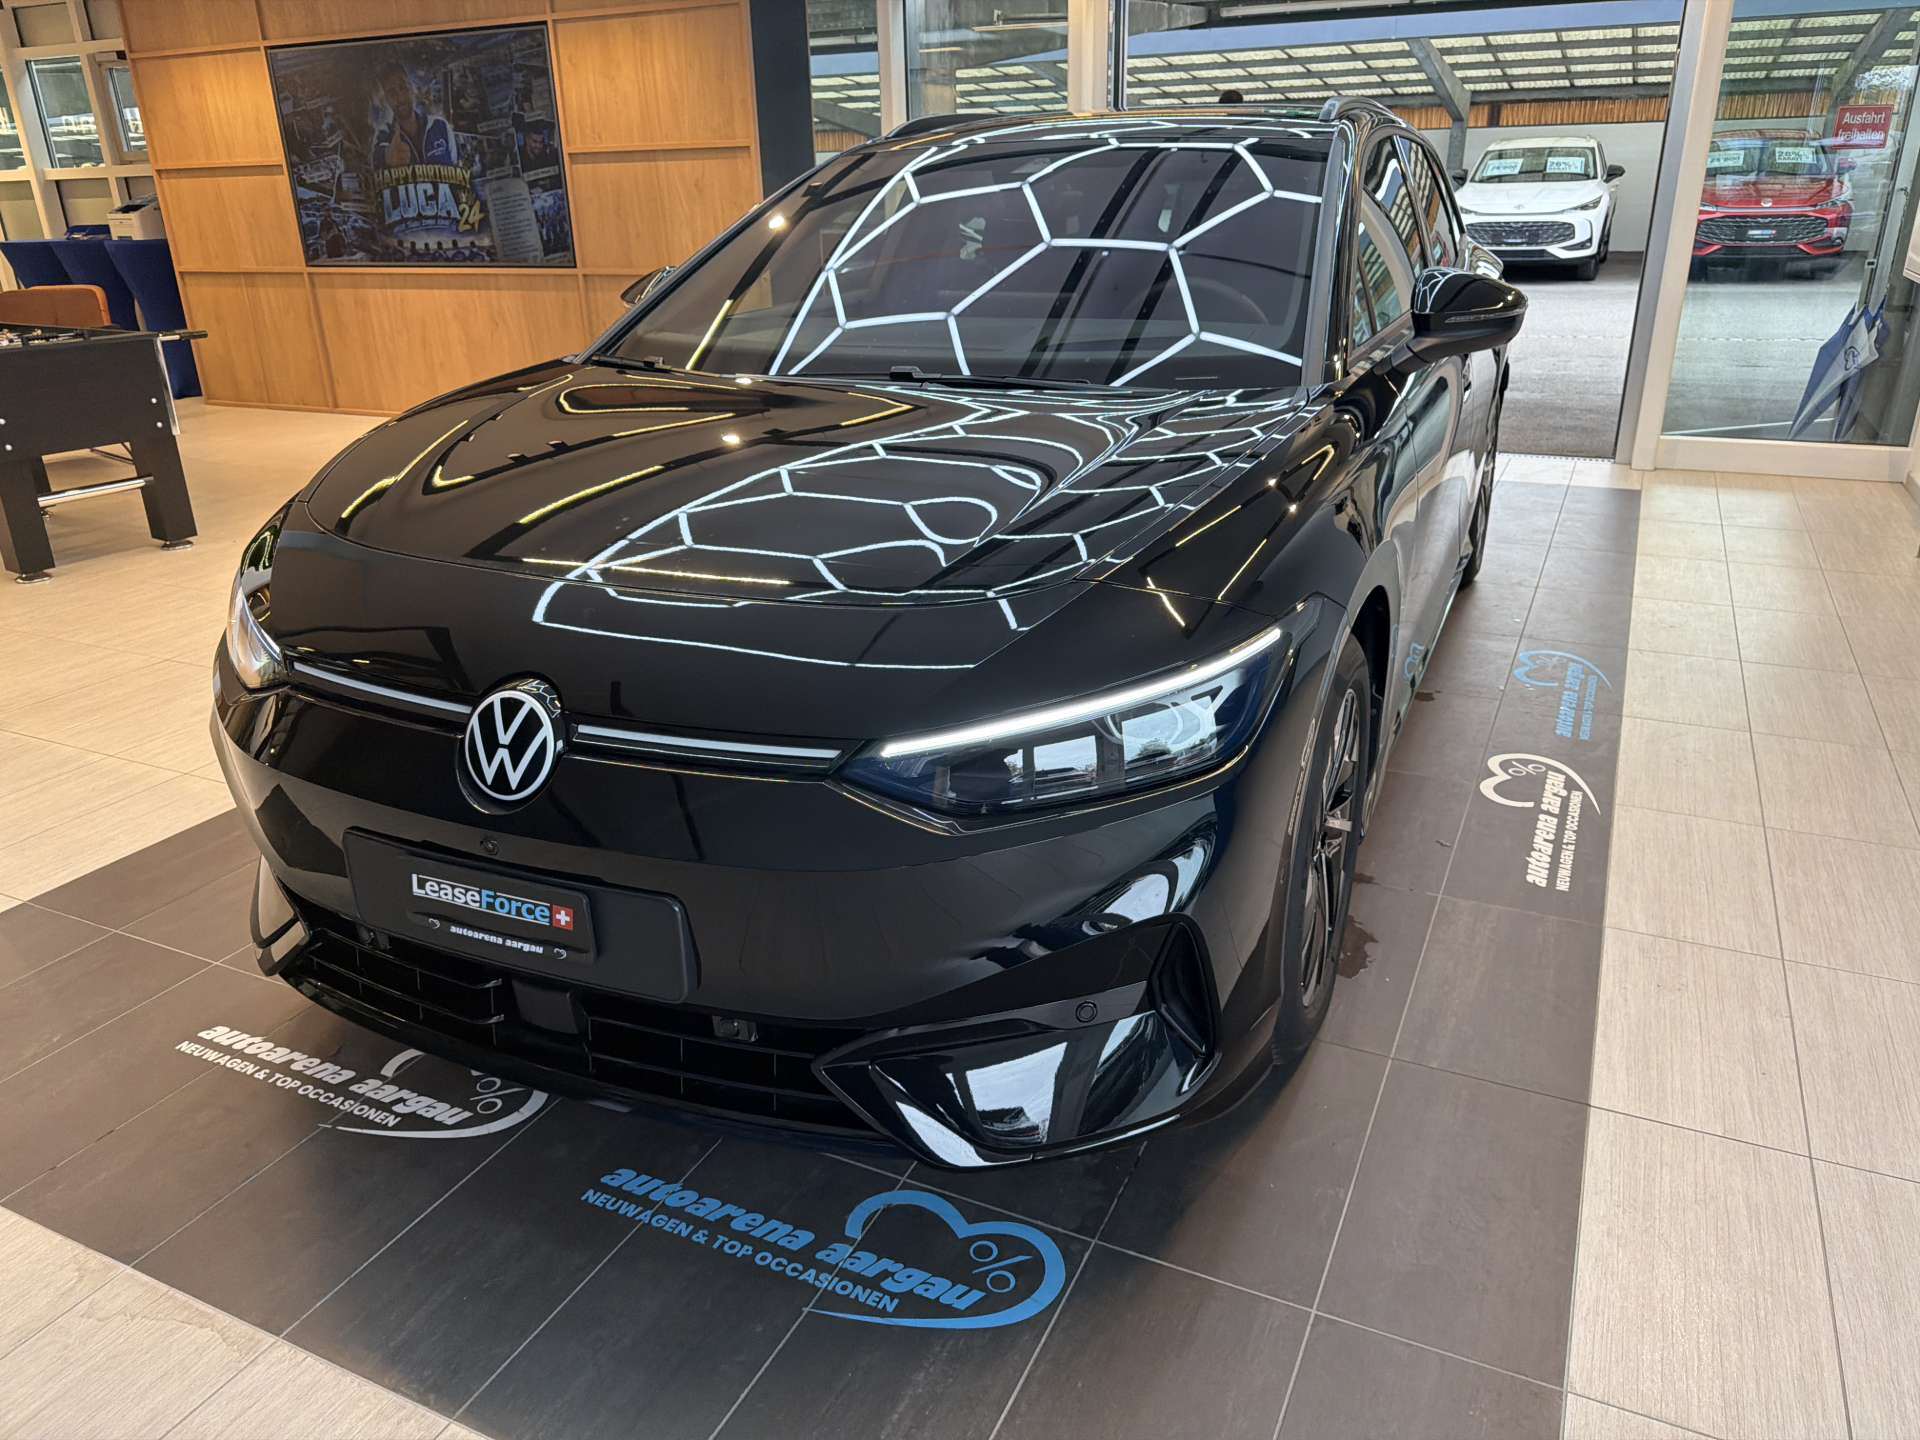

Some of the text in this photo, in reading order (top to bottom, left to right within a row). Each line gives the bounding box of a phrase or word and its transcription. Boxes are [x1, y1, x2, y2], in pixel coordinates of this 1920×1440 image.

[1838, 128, 1884, 141] freihalten
[1842, 111, 1885, 124] Ausfahrt
[374, 166, 412, 190] HAPPY
[415, 164, 471, 188] BIRTHDAY
[383, 182, 461, 224] LUCA
[458, 200, 485, 232] 24
[1525, 770, 1568, 888] autoarena aargau
[1563, 830, 1577, 844] TOP
[1555, 849, 1574, 892] NEUWAGEN
[412, 873, 550, 923] LeaseForce
[450, 924, 543, 954] autoarena aargau
[175, 1040, 402, 1128] NEUWAGEN & TOP OCCASIONEN
[197, 1025, 474, 1126] autoarena aargau
[581, 1188, 900, 1312] NEUWAGEN & TOP OCCASIONEN
[601, 1167, 986, 1311] autoarena aargau
